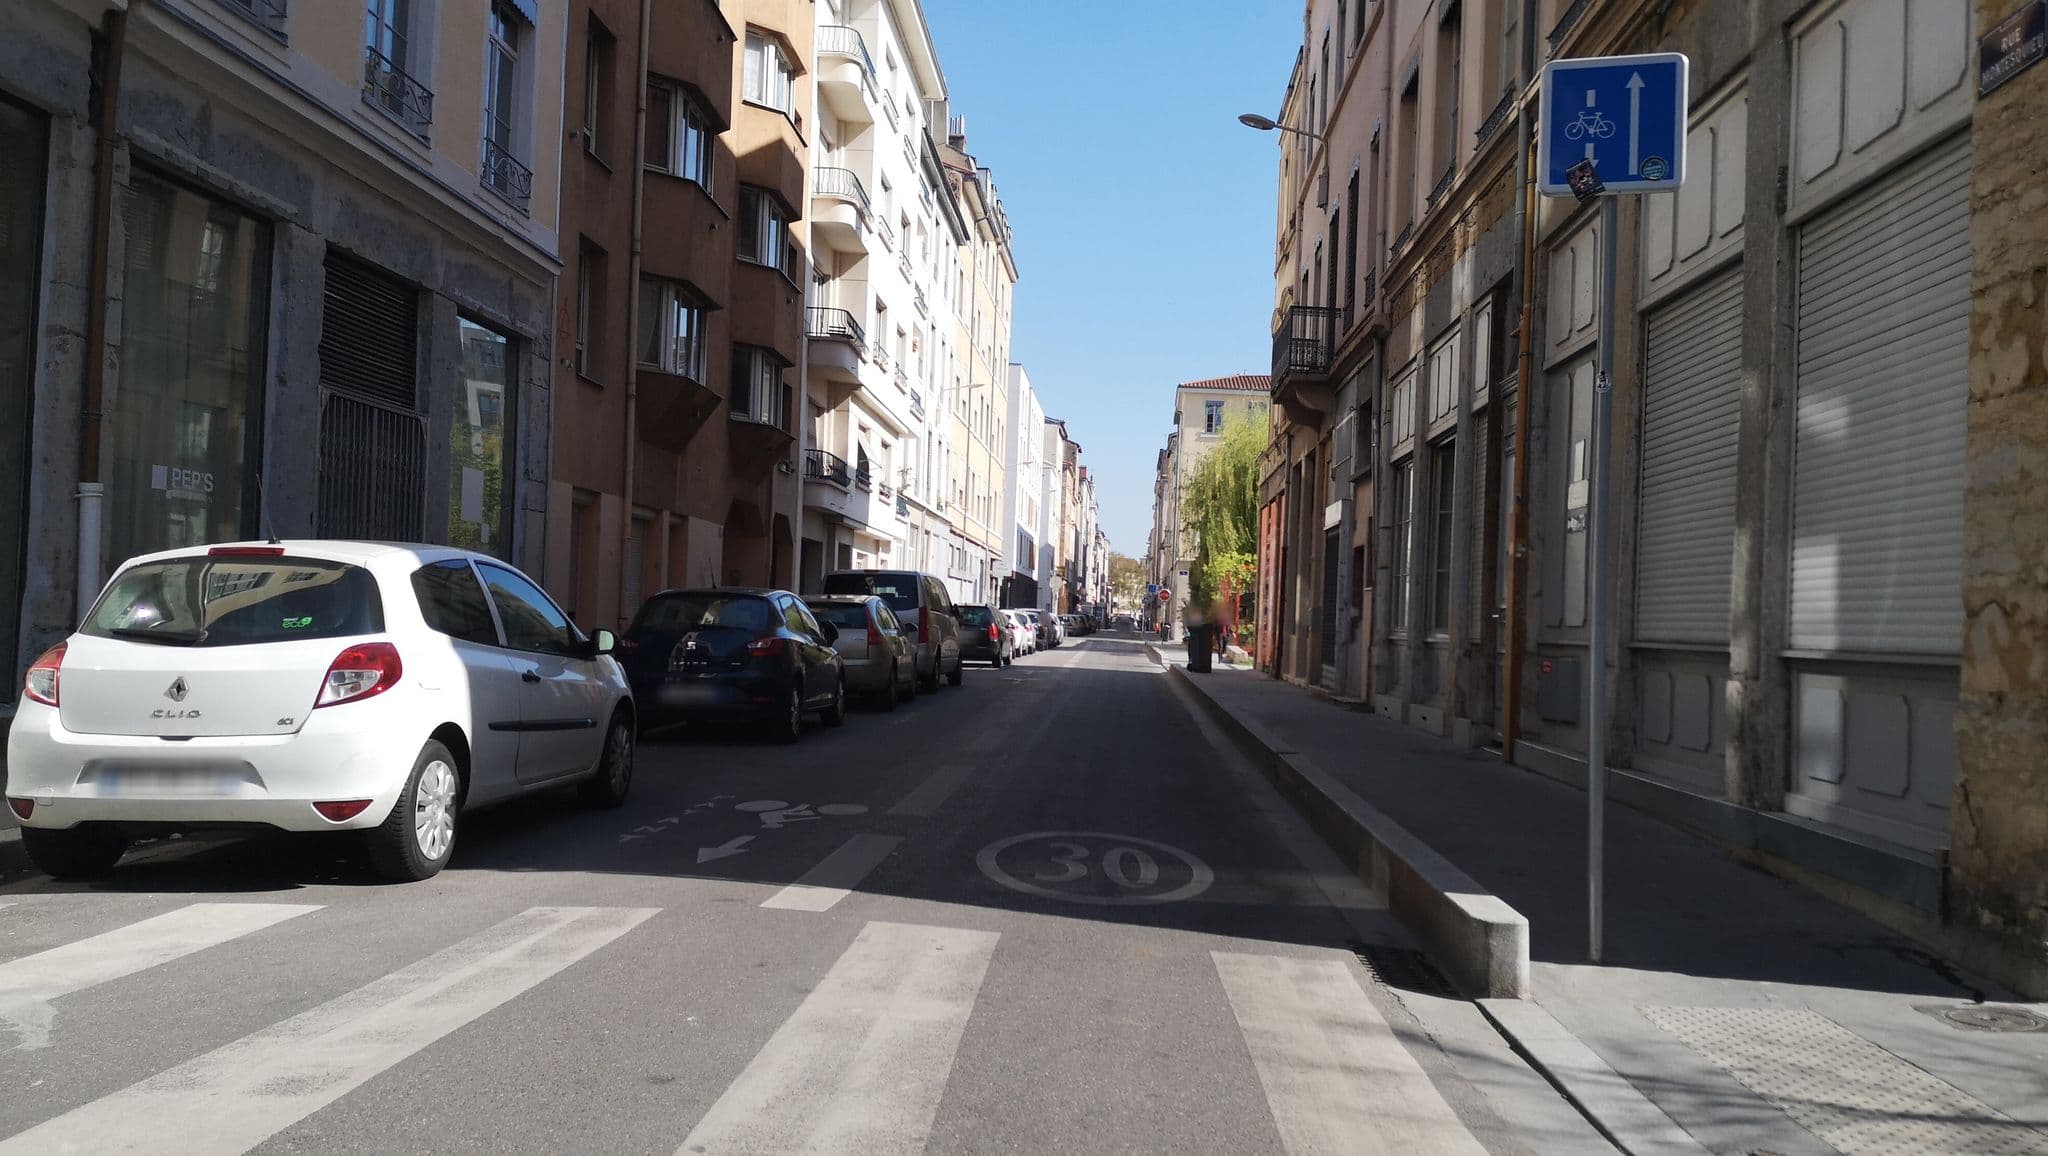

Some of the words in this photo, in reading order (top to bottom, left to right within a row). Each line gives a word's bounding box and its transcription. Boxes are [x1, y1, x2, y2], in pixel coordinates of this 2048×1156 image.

[2001, 27, 2022, 53] RUE
[171, 467, 214, 493] PEP'S
[150, 709, 201, 719] CLIO
[1034, 842, 1160, 889] 30
